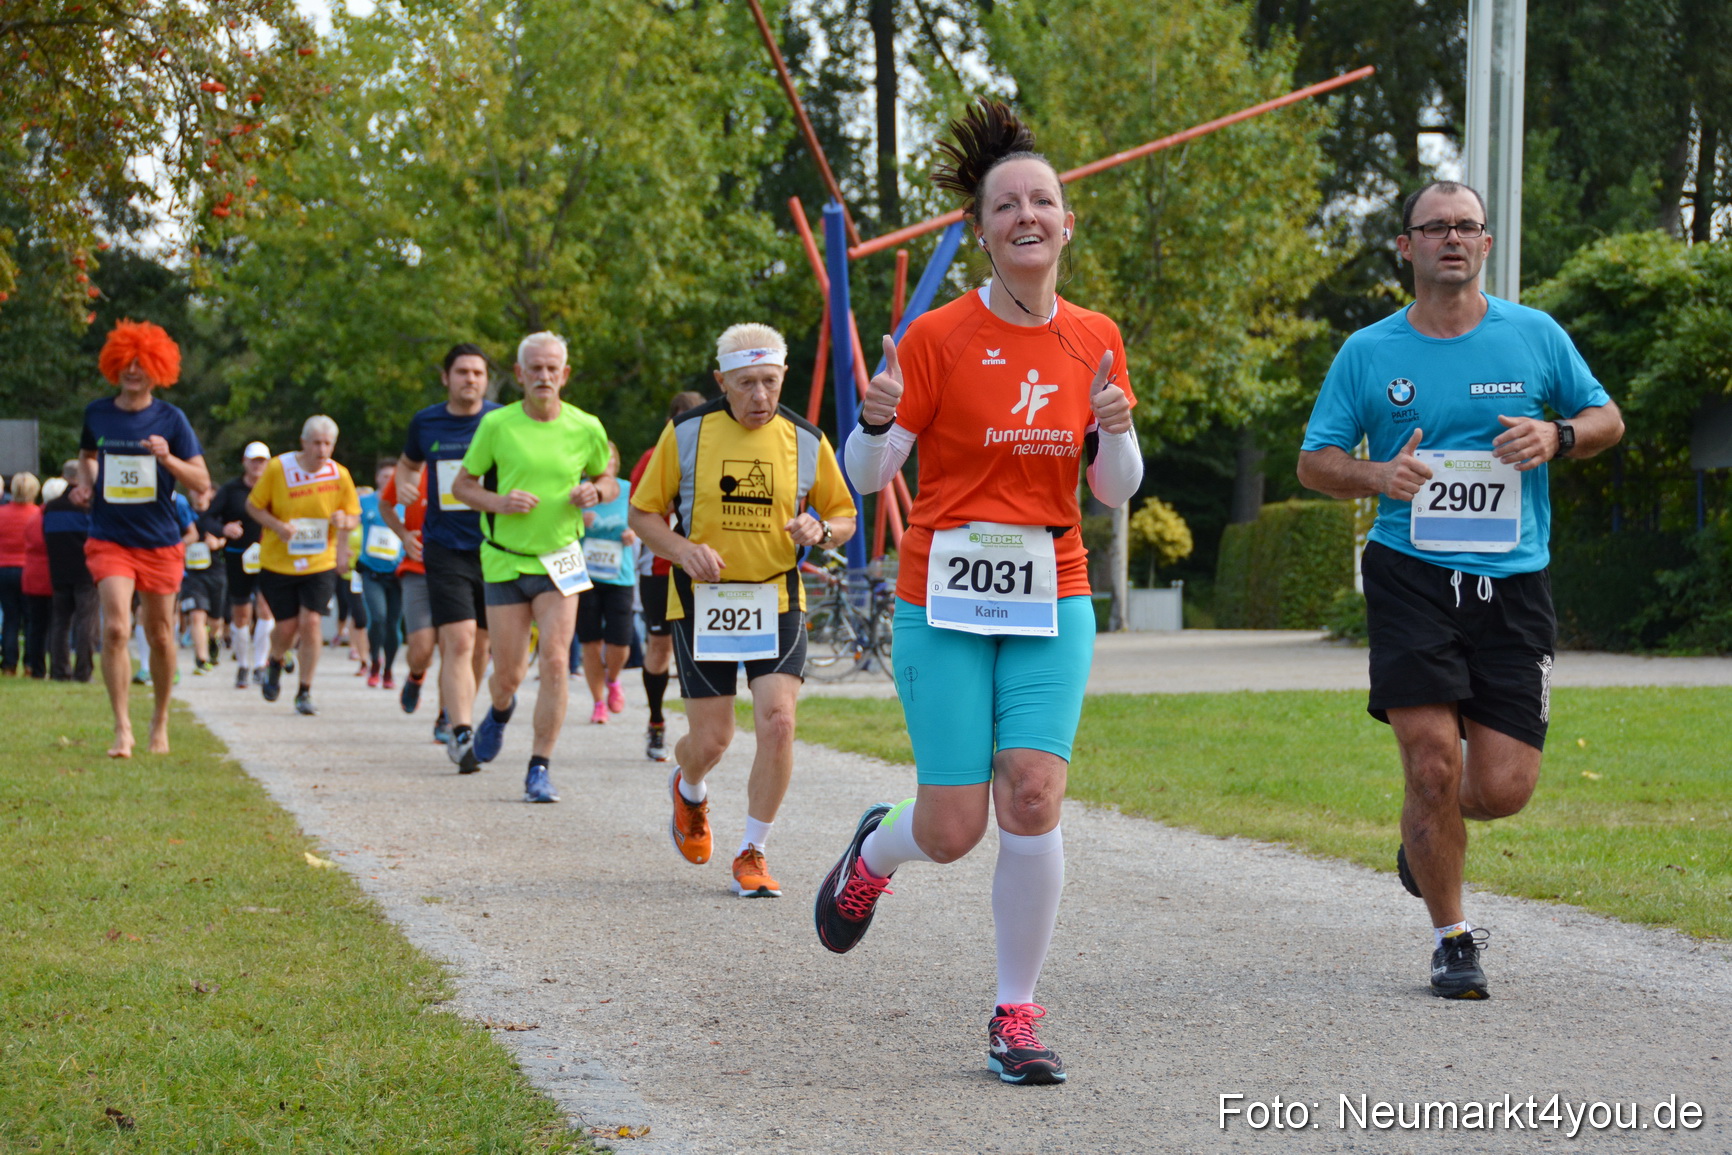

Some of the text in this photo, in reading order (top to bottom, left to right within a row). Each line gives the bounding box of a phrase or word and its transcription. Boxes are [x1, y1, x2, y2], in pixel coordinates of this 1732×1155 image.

[1470, 382, 1526, 395] BOCK
[1391, 409, 1419, 419] PARTL
[984, 427, 1074, 447] funrunners
[1012, 443, 1081, 458] neumarkt
[1455, 460, 1492, 469] BOCK
[120, 471, 139, 485] 35
[1429, 482, 1505, 512] 2907
[722, 504, 771, 517] HIRSCH
[980, 534, 1024, 544] BOCK
[947, 556, 1034, 594] 2031
[975, 605, 1009, 618] Karin
[707, 608, 762, 631] 2921
